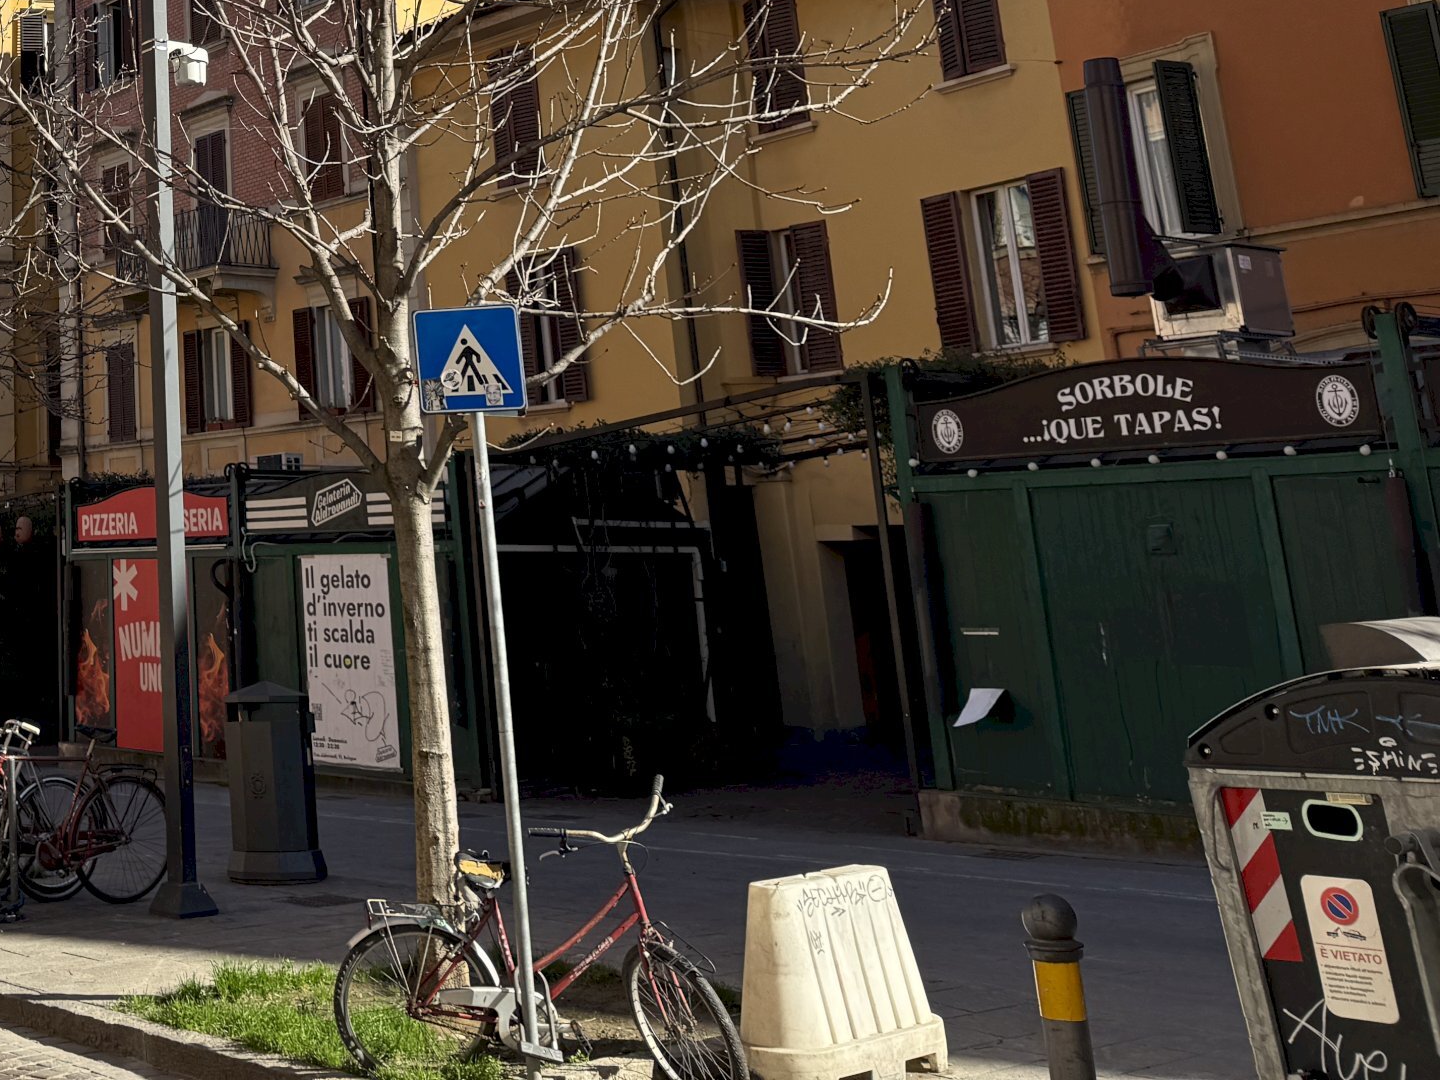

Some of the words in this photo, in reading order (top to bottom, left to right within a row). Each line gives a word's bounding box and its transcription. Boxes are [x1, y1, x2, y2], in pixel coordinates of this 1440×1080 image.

[1057, 373, 1194, 412] SORBOLE
[1114, 406, 1222, 436] TAPAS!
[315, 490, 358, 523] Aldrovandi
[317, 483, 351, 509] Gelateria
[81, 512, 138, 536] PIZZERIA
[183, 507, 223, 532] SERIA
[305, 565, 315, 589] Il
[320, 565, 371, 595] gelato
[306, 593, 386, 618] d'inverno
[118, 621, 161, 662] NUM
[307, 620, 318, 642] ti
[323, 619, 375, 644] scalda
[309, 644, 319, 668] il
[324, 653, 371, 670] cuore
[1320, 945, 1329, 959] È
[1330, 948, 1383, 965] VIETATO
